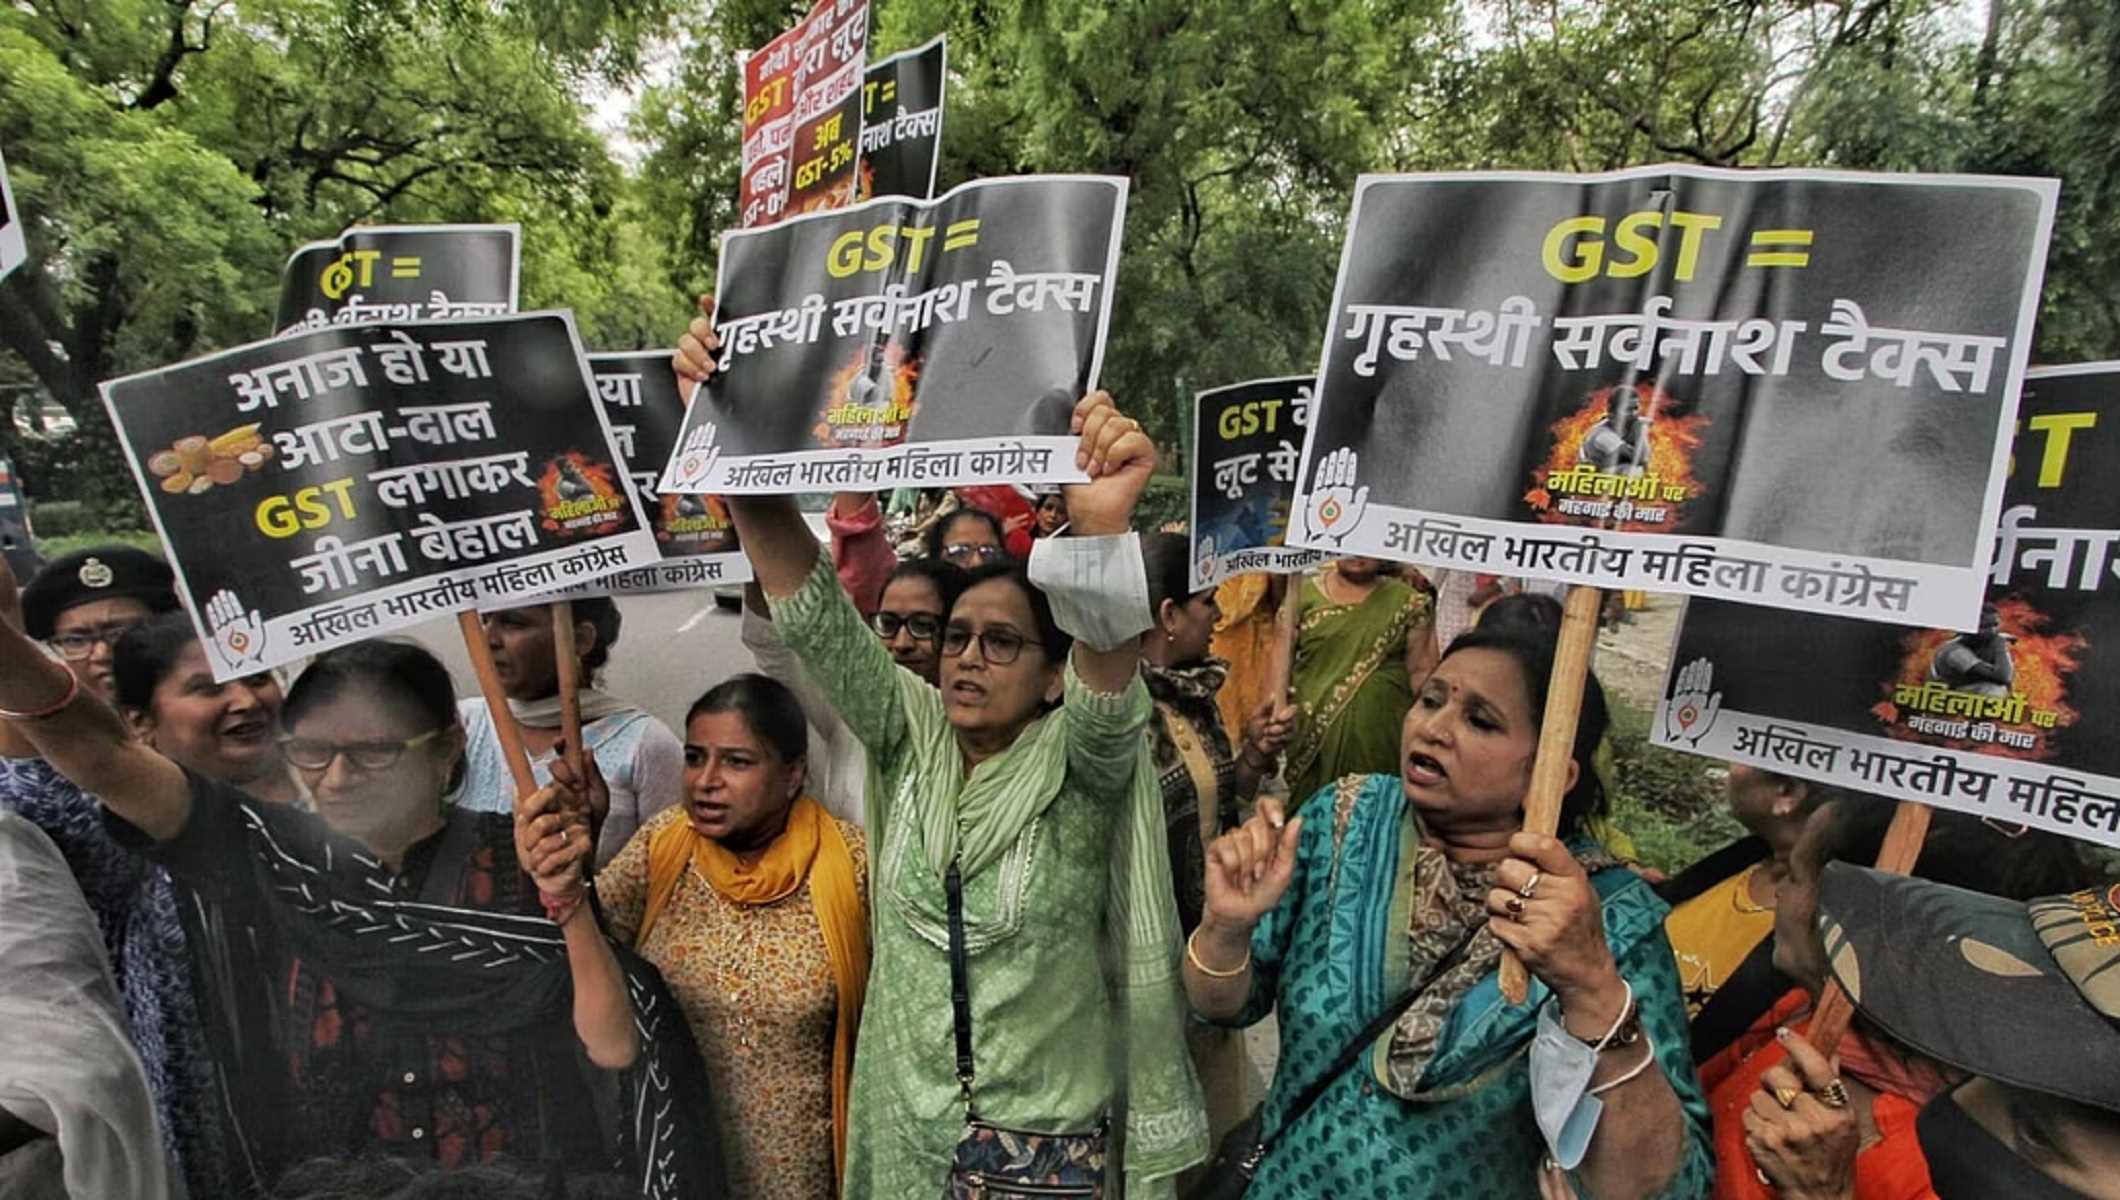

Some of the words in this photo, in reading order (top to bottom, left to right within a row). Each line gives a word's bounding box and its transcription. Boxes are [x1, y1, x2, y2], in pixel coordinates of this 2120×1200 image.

[747, 77, 788, 125] GST
[831, 4, 866, 62] लूट
[813, 112, 843, 150] अब
[894, 106, 940, 143] टैक्स
[827, 223, 935, 279] GST
[1541, 210, 1723, 284] GST
[715, 292, 829, 373] गृहस्थी
[831, 279, 979, 338] सर्वनाश
[985, 260, 1101, 315] टैक्स
[1345, 295, 1542, 377] गृहस्थी
[1553, 296, 1807, 376] सर्वनाश
[1820, 299, 2007, 393] टैक्स
[228, 346, 370, 412] अनाज
[371, 329, 430, 385] हो
[430, 340, 492, 379] या
[272, 401, 497, 470] आटा-दाल
[1218, 400, 1283, 441] GST
[255, 477, 358, 539] GST
[367, 451, 538, 508] लगाकर
[723, 458, 797, 488] अखिल
[799, 452, 884, 485] भारतीय
[886, 446, 961, 480] महिला
[970, 442, 1053, 475] कांग्रेस
[1214, 452, 1261, 500] लूट
[1267, 440, 1299, 482] से
[290, 531, 409, 595] जीना
[411, 508, 540, 563] बेहाल
[661, 557, 723, 584] कांग्रेस
[1384, 519, 1496, 563] अखिल
[1505, 535, 1633, 578] भारतीय
[1642, 544, 1772, 593] महिला
[1780, 562, 1919, 612] कांग्रेस
[288, 602, 379, 649] अखिल
[384, 573, 479, 621] भारतीय
[481, 559, 557, 598] महिला
[557, 542, 629, 579] कांग्रेस
[1895, 682, 2028, 724] महिलाओं
[1732, 724, 1843, 774] अखिल
[1850, 745, 1998, 803] भारतीय
